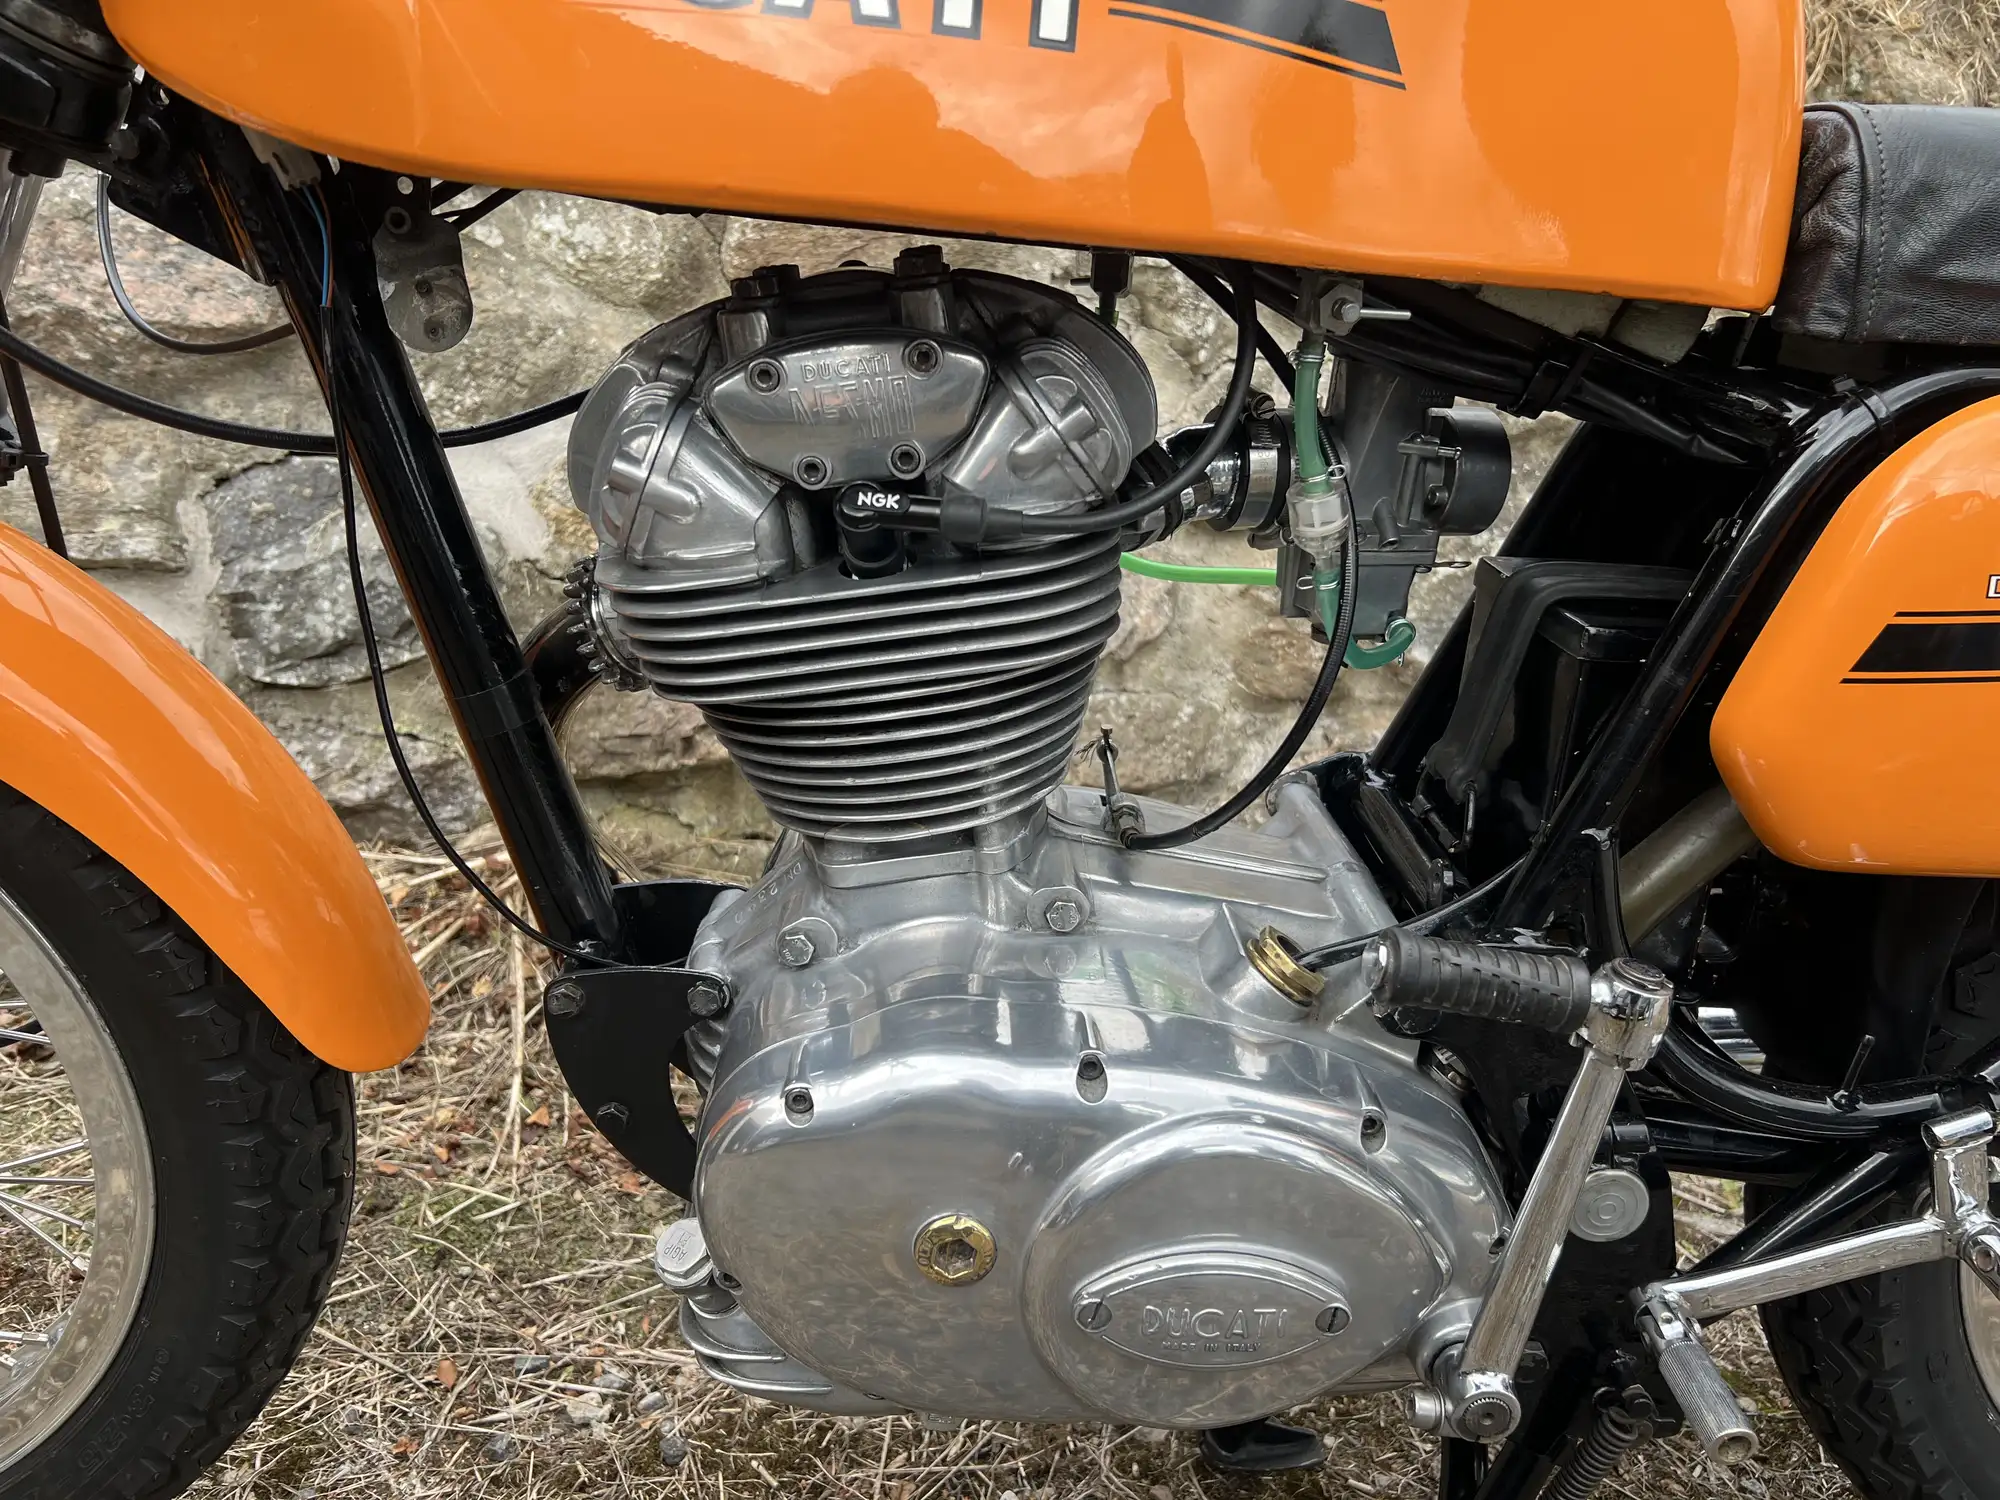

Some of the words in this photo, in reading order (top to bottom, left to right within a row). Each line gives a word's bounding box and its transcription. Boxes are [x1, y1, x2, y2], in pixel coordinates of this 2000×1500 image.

[801, 352, 891, 382] DUCATI
[857, 491, 901, 509] NGK
[663, 1244, 688, 1262] AGIP
[1141, 1304, 1288, 1339] DUCATI
[1203, 1342, 1219, 1352] IN
[1225, 1341, 1262, 1352] ITALY
